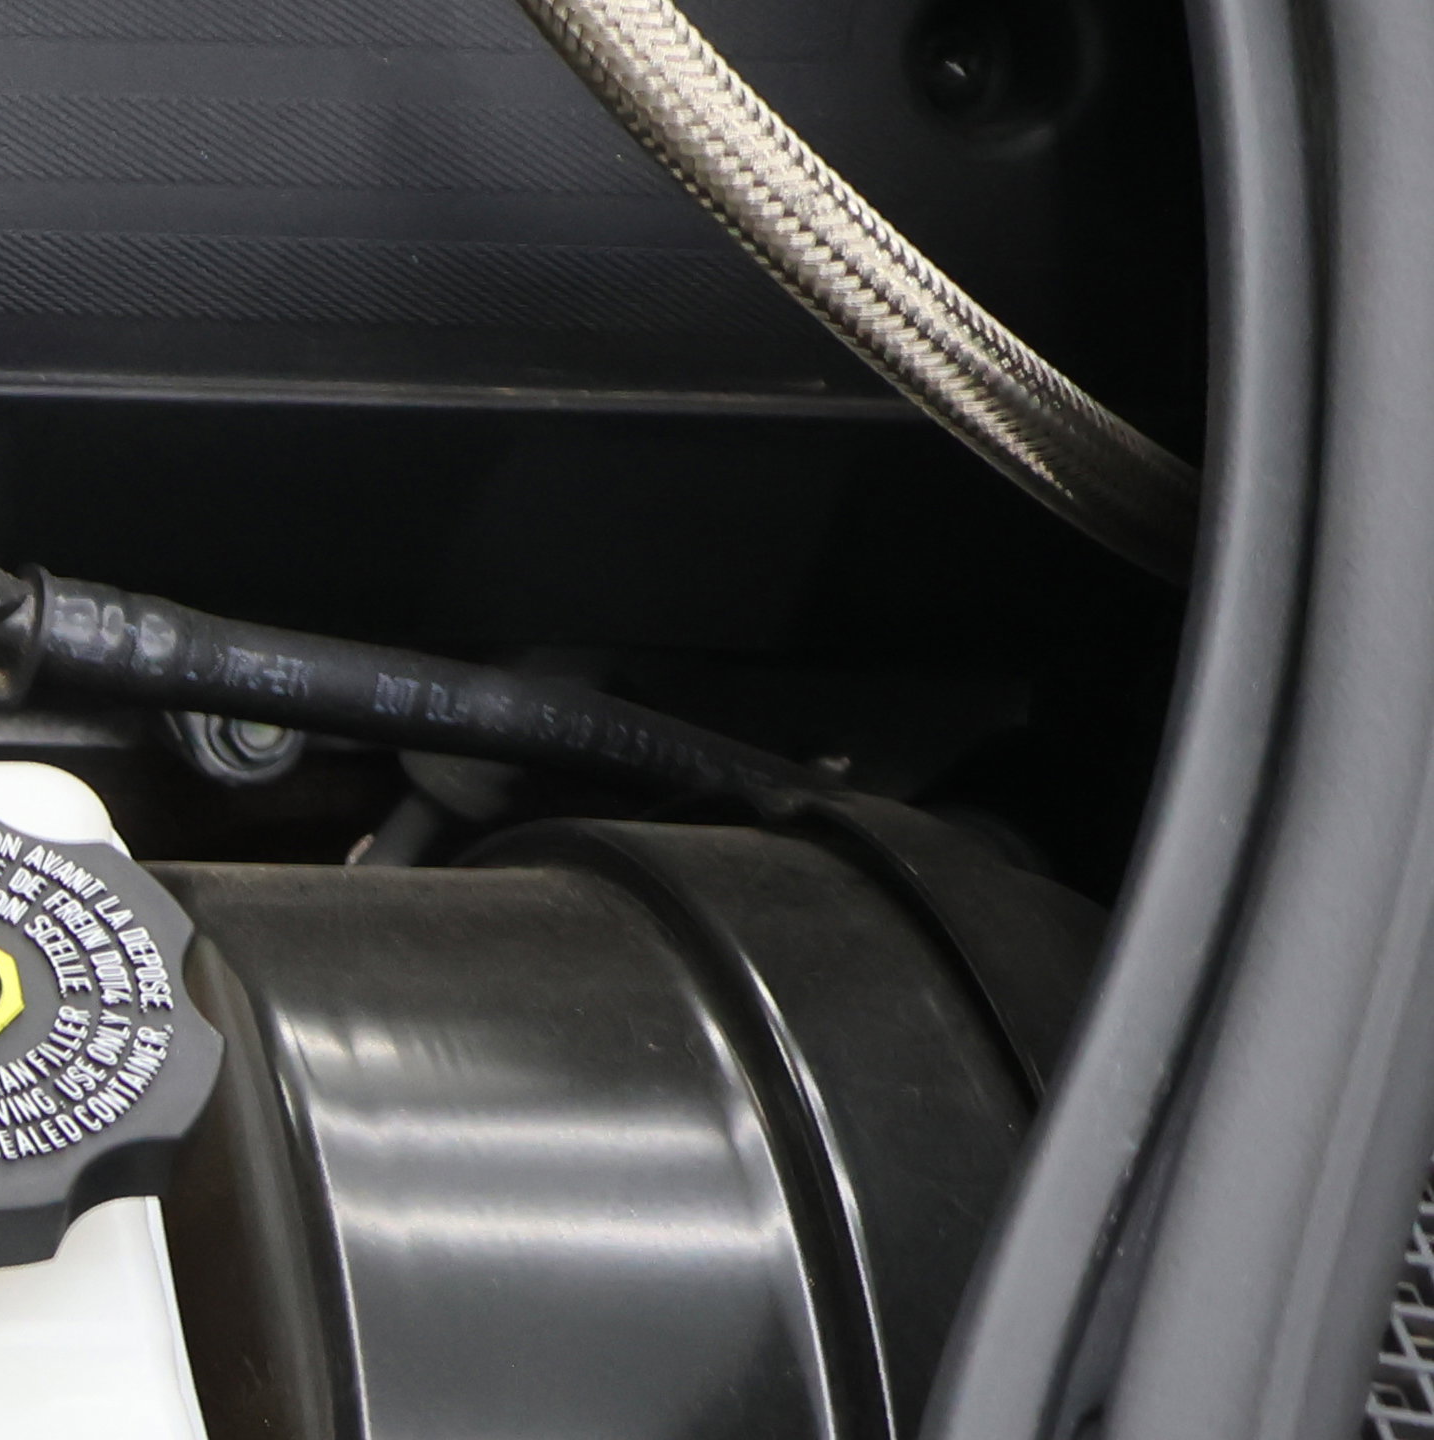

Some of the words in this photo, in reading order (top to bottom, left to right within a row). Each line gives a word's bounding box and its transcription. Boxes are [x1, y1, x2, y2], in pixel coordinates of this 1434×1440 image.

[9, 867, 47, 901] DE
[43, 889, 111, 950] FREIN
[23, 845, 107, 899] AVANT
[94, 895, 134, 930] LA
[25, 1005, 91, 1077] FILLER
[54, 1056, 107, 1101] USE
[86, 1009, 132, 1065] ONLY
